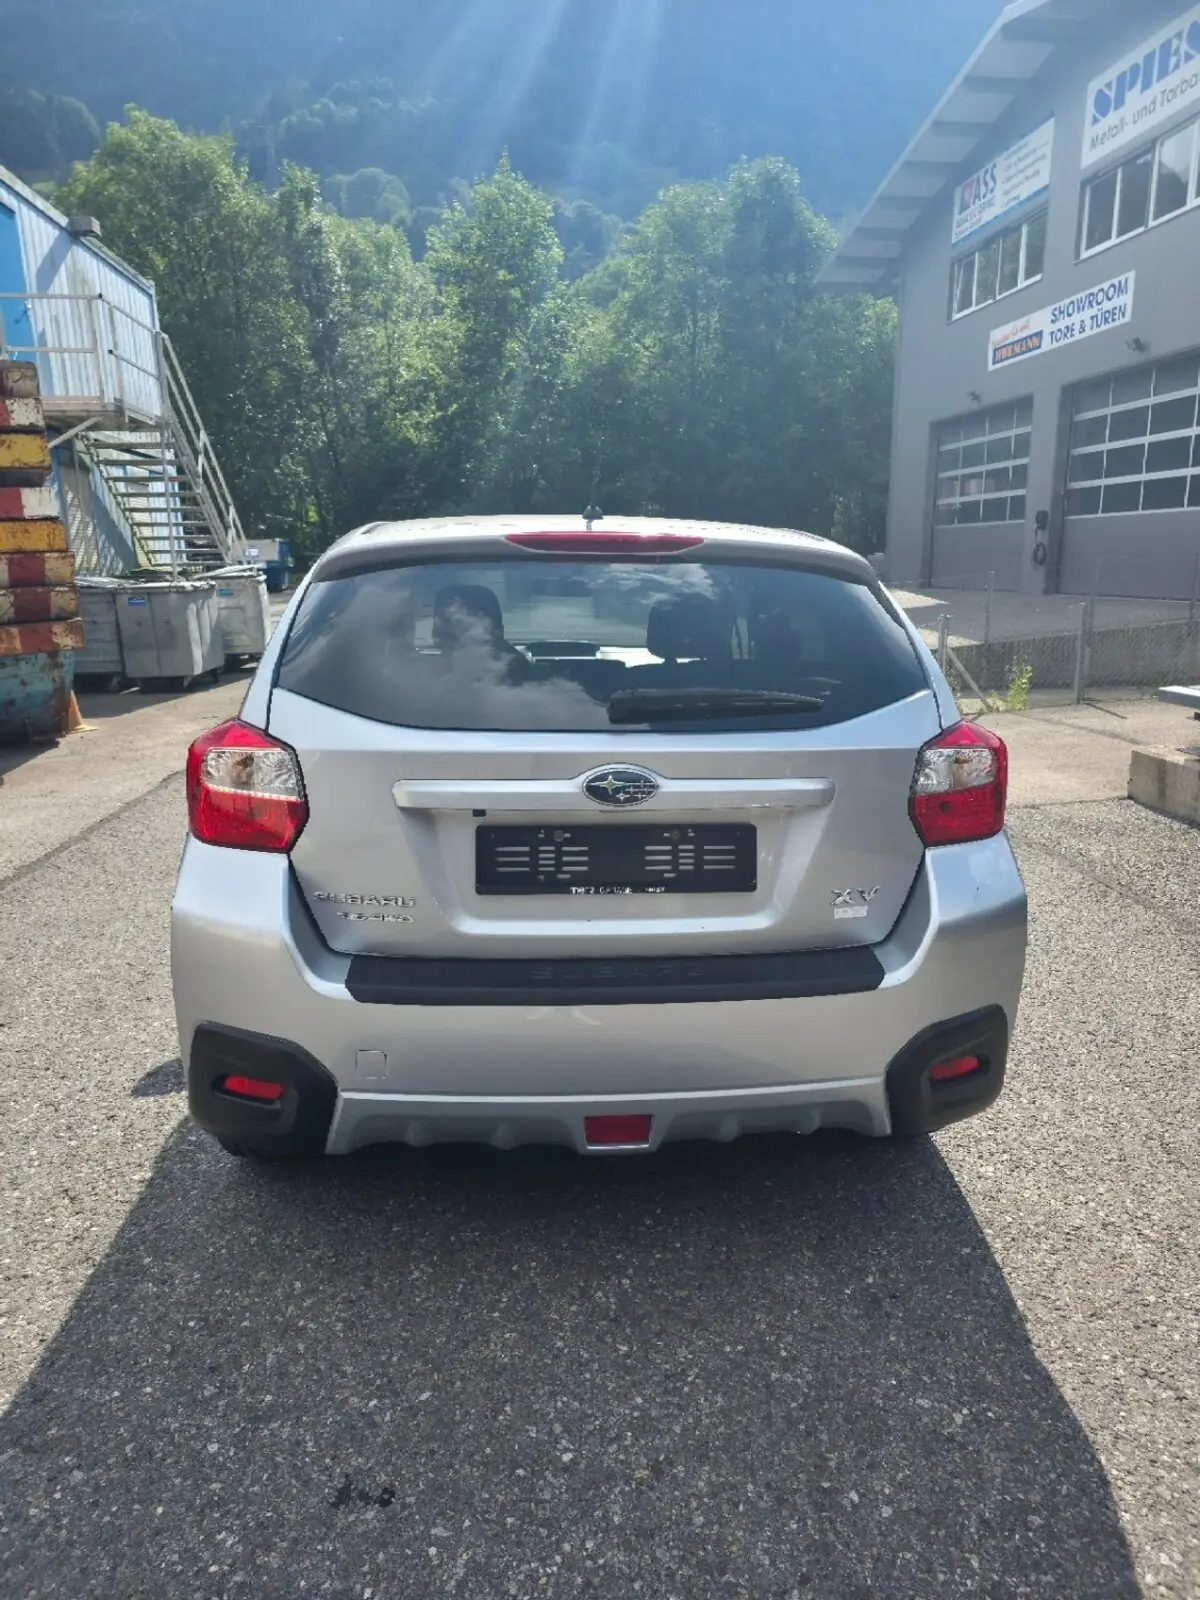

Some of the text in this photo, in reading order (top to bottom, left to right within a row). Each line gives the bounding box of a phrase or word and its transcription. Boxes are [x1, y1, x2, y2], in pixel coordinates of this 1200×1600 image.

[1132, 94, 1157, 126] und
[1050, 276, 1129, 324] SHOWROOM
[1049, 321, 1076, 345] TORE
[1078, 319, 1087, 336] &
[1090, 303, 1127, 332] TÜREN
[313, 891, 416, 908] SUBARU
[830, 886, 880, 905] XV
